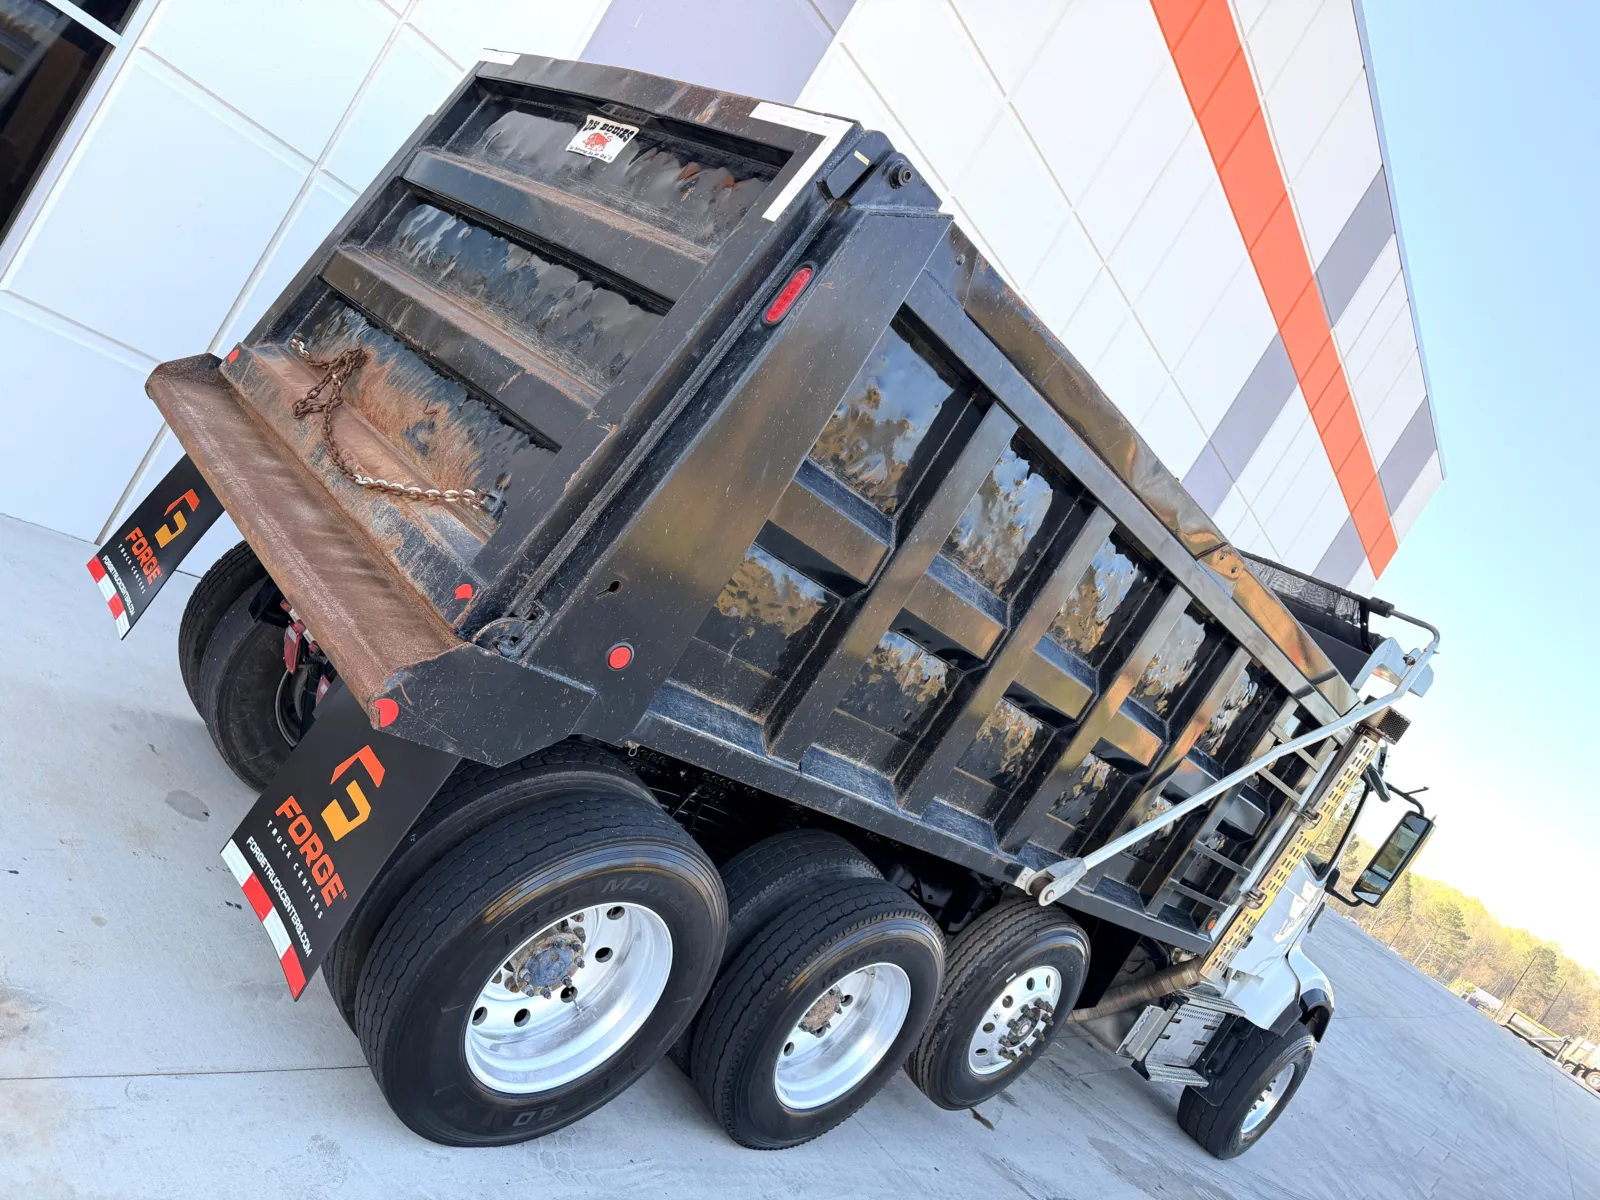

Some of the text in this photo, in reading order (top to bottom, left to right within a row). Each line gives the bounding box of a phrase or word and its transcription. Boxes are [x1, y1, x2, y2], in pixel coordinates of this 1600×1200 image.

[599, 123, 635, 143] BODIES
[102, 554, 135, 617] FORGETRUCKCENTERS.COM
[118, 543, 147, 595] TRUCK CENTERS
[124, 526, 162, 585] FORGE
[266, 819, 323, 919] TRUCK CENTERS
[275, 795, 344, 907] FORGE
[246, 836, 313, 958] FORGETRUCKCENTERS.COM
